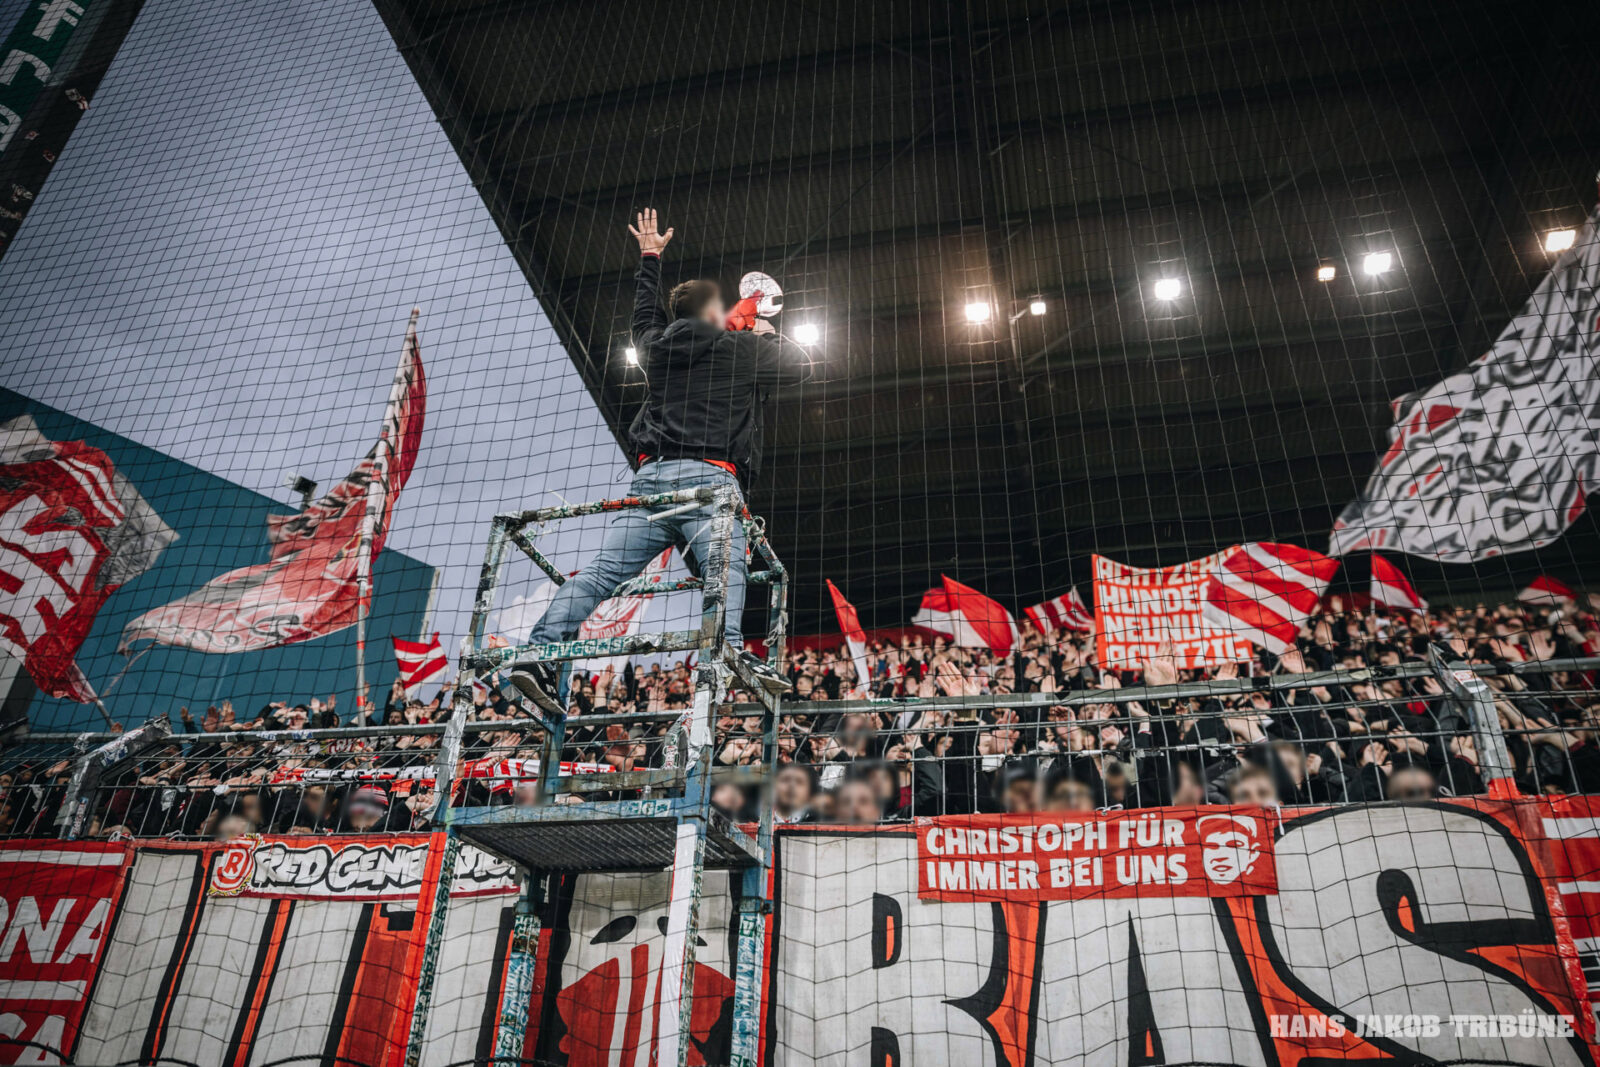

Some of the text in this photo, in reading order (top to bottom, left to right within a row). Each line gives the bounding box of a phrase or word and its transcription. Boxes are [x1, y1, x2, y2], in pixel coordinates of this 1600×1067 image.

[1098, 581, 1210, 615] HUNDE
[1105, 614, 1236, 643] NEUNUN
[925, 813, 1186, 856] CHRISTOPH FÜR
[253, 846, 330, 887] RED
[926, 853, 1189, 891] IMMER BEI UNS
[0, 896, 112, 964] NA
